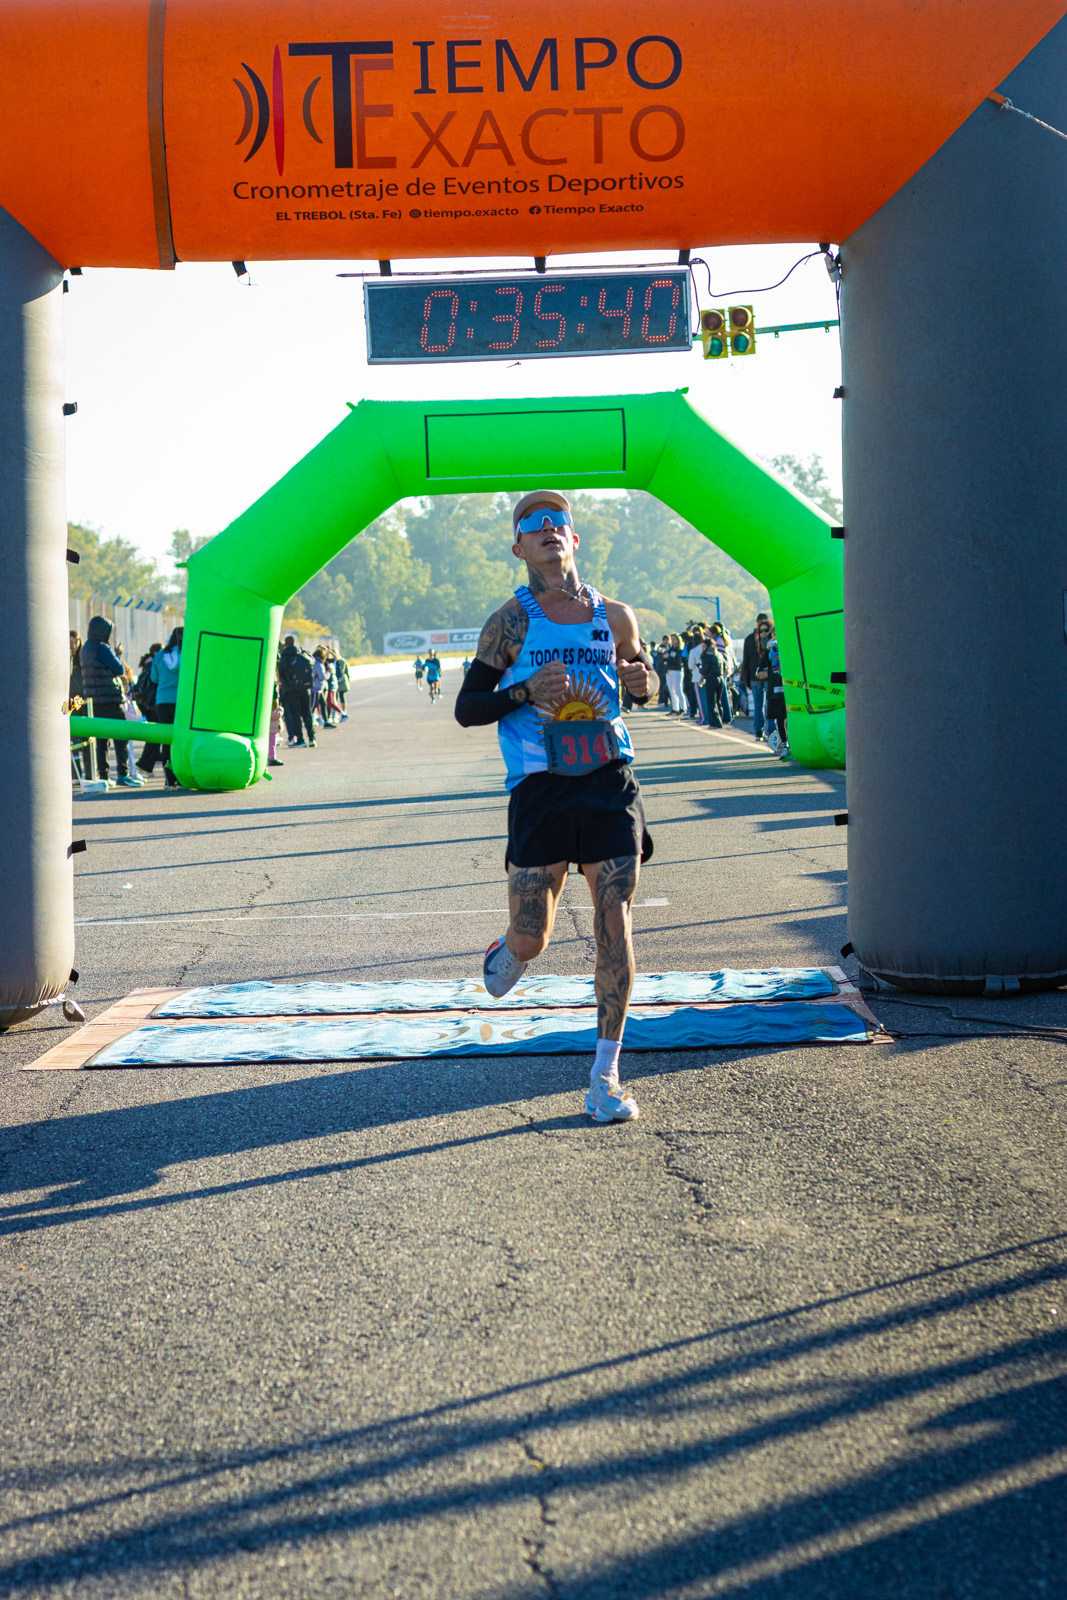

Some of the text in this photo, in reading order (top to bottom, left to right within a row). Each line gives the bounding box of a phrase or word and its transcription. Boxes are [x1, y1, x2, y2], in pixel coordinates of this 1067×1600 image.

[233, 172, 684, 201] Cronometraje de Eventos Deportivos
[276, 211, 292, 221] EL
[294, 211, 346, 221] TREBOL
[350, 209, 379, 221] (Sta.
[382, 209, 401, 220] Fe)
[544, 204, 596, 216] Tiempo
[599, 203, 644, 214] Exacto
[420, 280, 679, 352] 0:35:40
[529, 648, 560, 667] TODO
[563, 648, 575, 665] ES
[562, 733, 609, 765] 314
